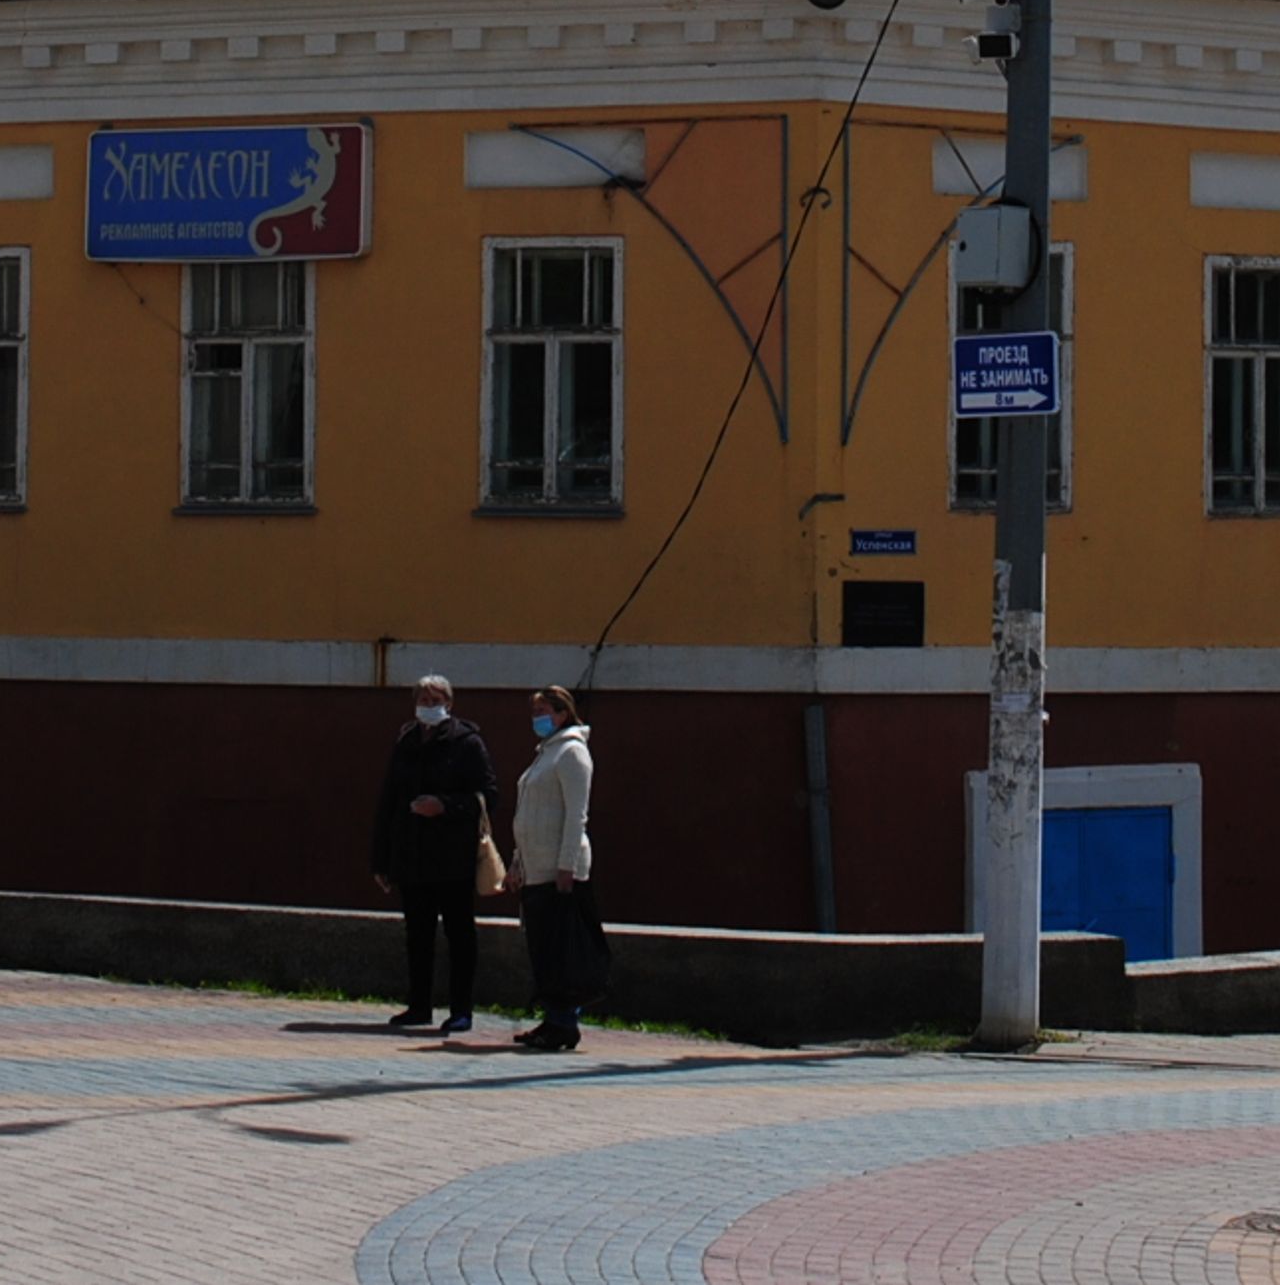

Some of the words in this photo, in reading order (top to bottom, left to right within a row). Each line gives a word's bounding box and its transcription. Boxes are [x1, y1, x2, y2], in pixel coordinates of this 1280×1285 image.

[102, 140, 271, 203] ХАМЕЛЕОН
[100, 222, 175, 241] РЕКЛАМНОЕ
[177, 221, 245, 240] АГЕНТСТВО
[978, 345, 1030, 366] ПРОЕЗД
[960, 370, 977, 389] НЕ
[980, 367, 1049, 388] ЗАНИМАТЬ
[856, 539, 912, 552] Успенская
